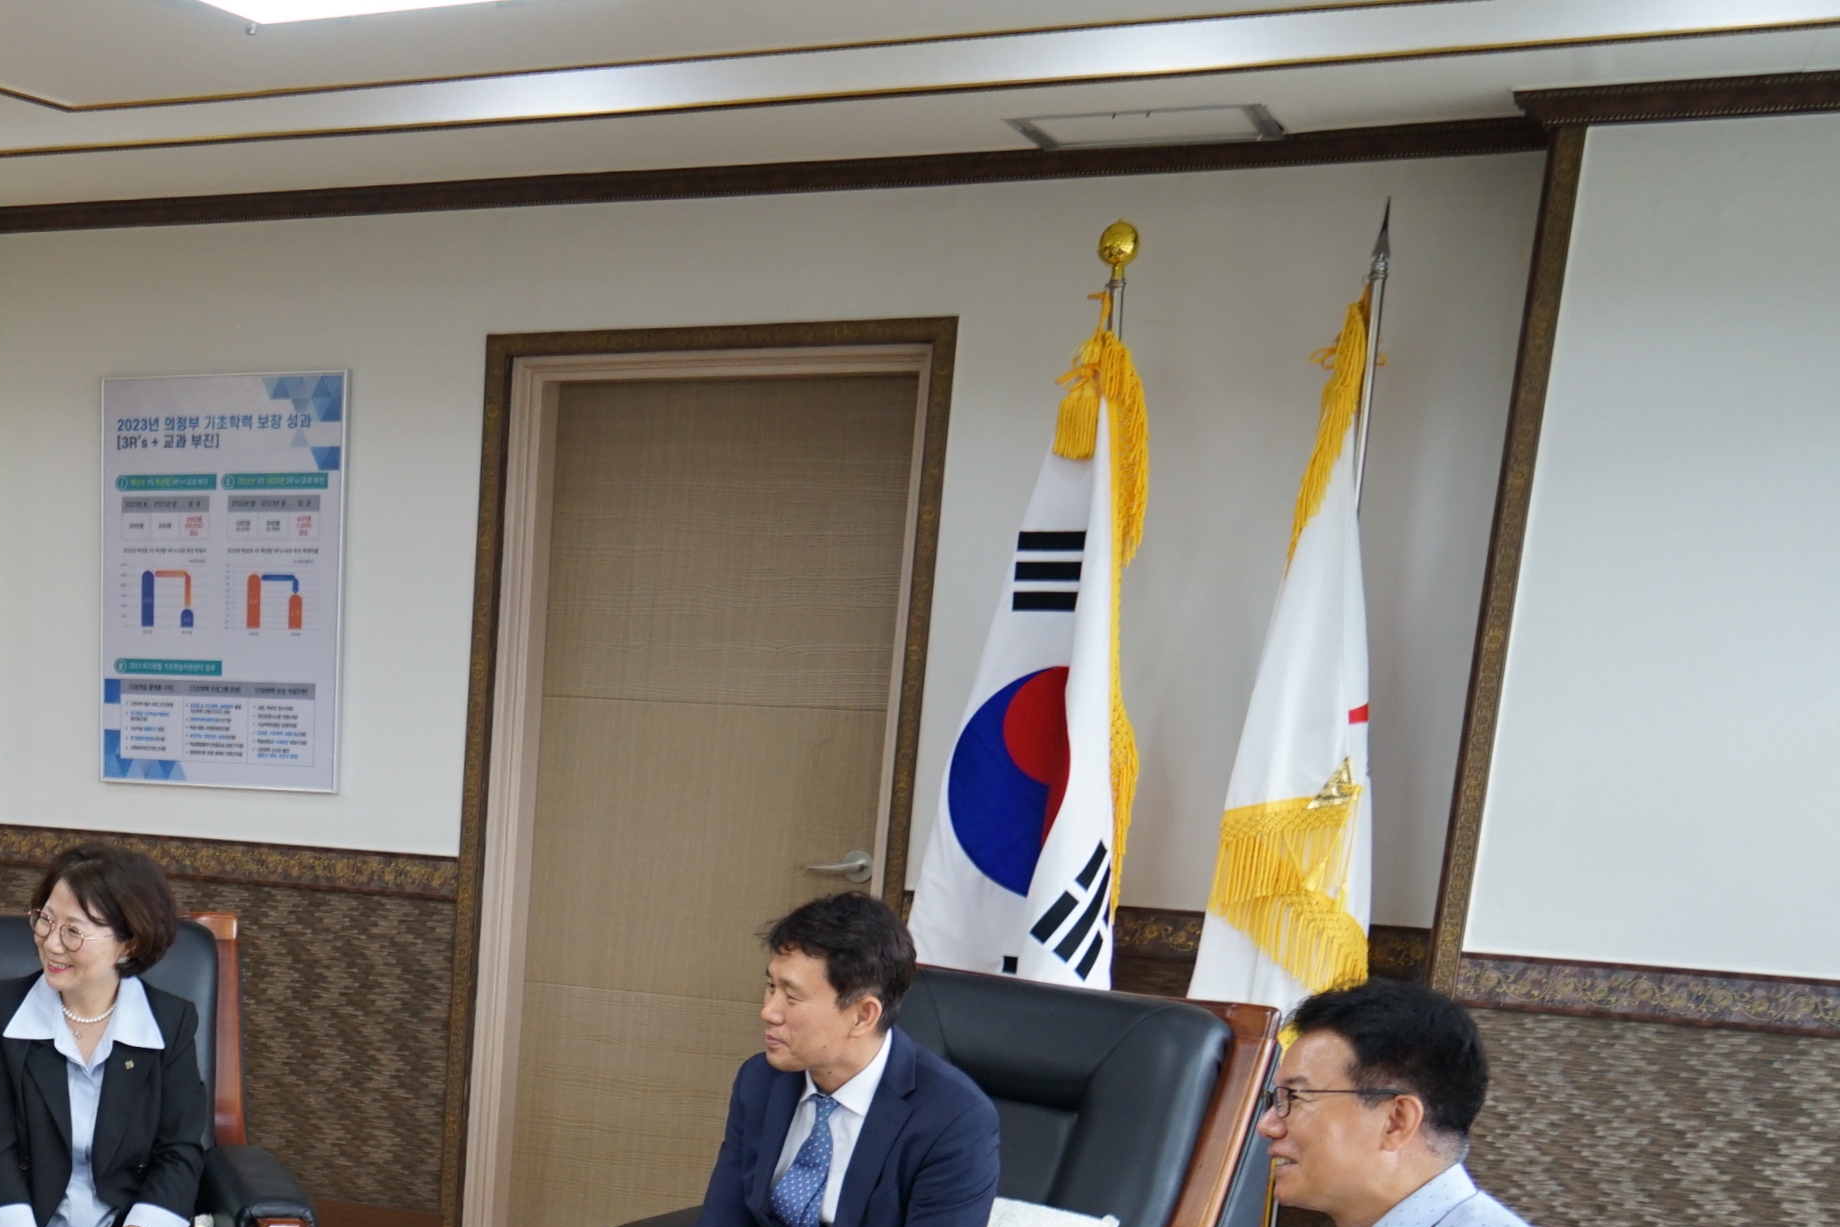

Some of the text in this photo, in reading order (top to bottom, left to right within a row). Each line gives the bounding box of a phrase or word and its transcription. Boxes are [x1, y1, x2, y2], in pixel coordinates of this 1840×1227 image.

[117, 413, 312, 432] 2023년 의정부 기초학력 보장 성과
[162, 434, 187, 449] 교과
